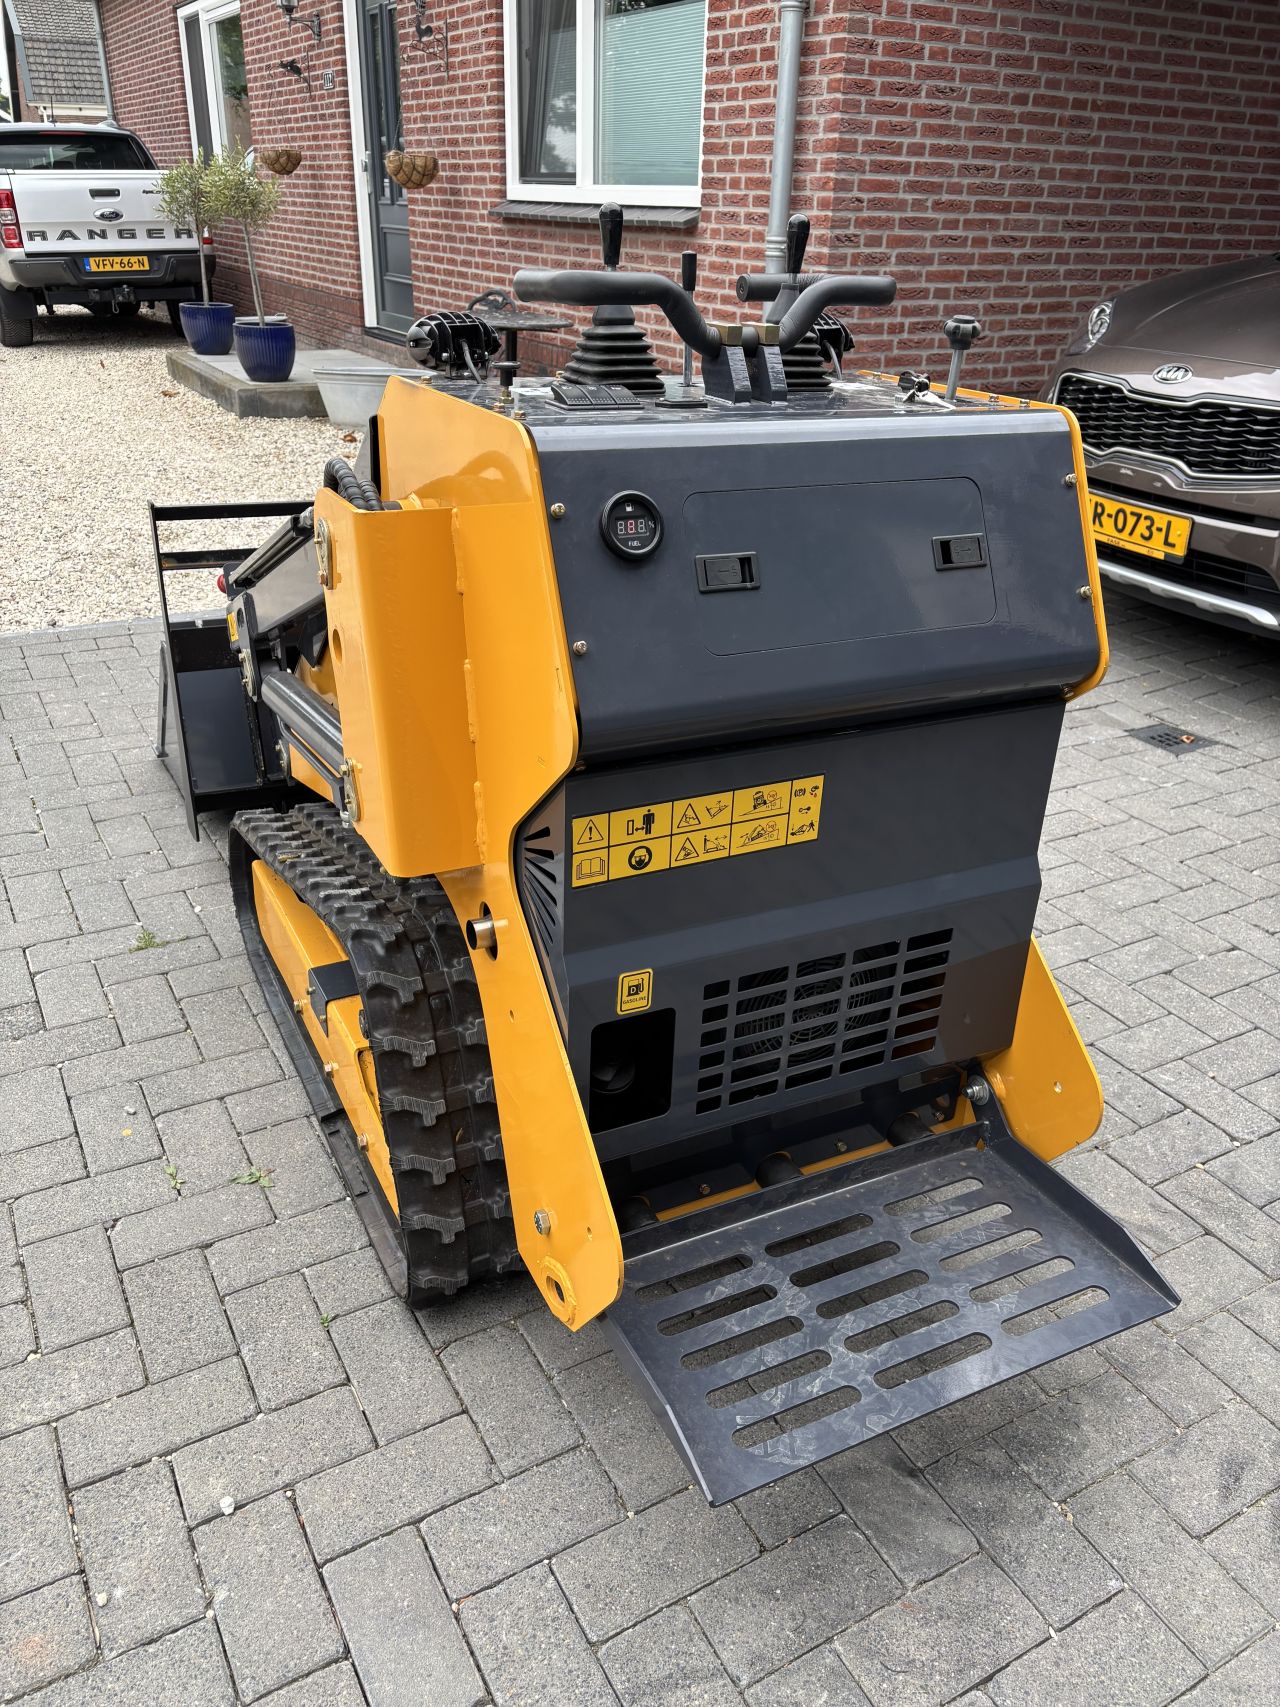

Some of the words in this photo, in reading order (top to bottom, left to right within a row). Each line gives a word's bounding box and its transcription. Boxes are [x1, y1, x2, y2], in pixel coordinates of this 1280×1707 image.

[26, 228, 194, 241] RANGER
[94, 256, 146, 270] VFV-66-N
[1157, 366, 1187, 381] KIA
[1089, 499, 1177, 549] R-073-L
[622, 996, 647, 1004] GASOLINE
